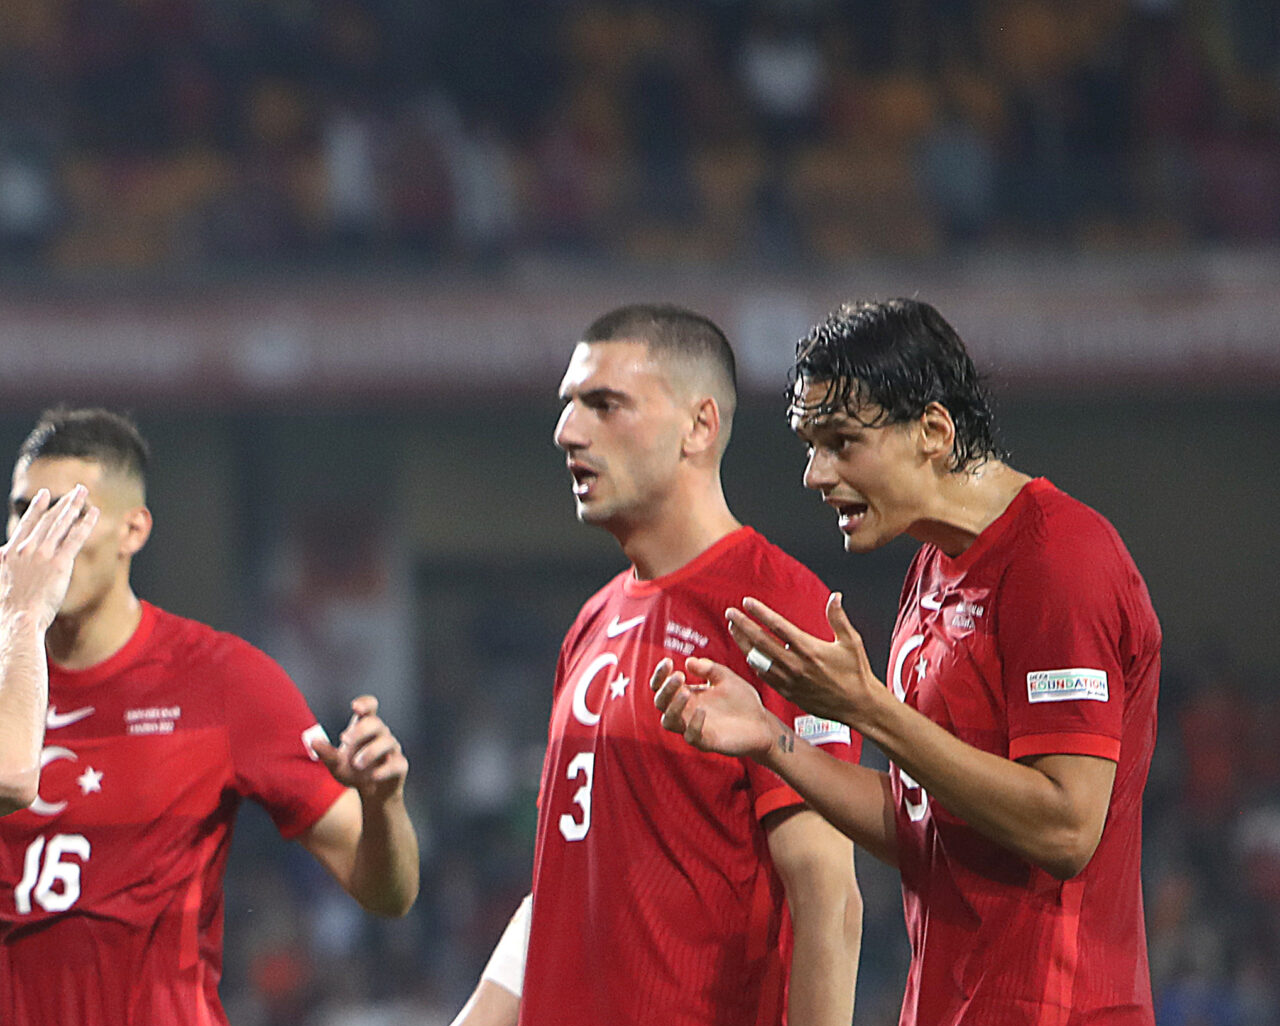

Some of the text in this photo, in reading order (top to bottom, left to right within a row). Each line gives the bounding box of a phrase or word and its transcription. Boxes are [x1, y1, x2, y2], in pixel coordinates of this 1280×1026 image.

[1030, 678, 1106, 691] FOUNDATION
[559, 752, 595, 842] 3
[14, 833, 91, 915] 16
